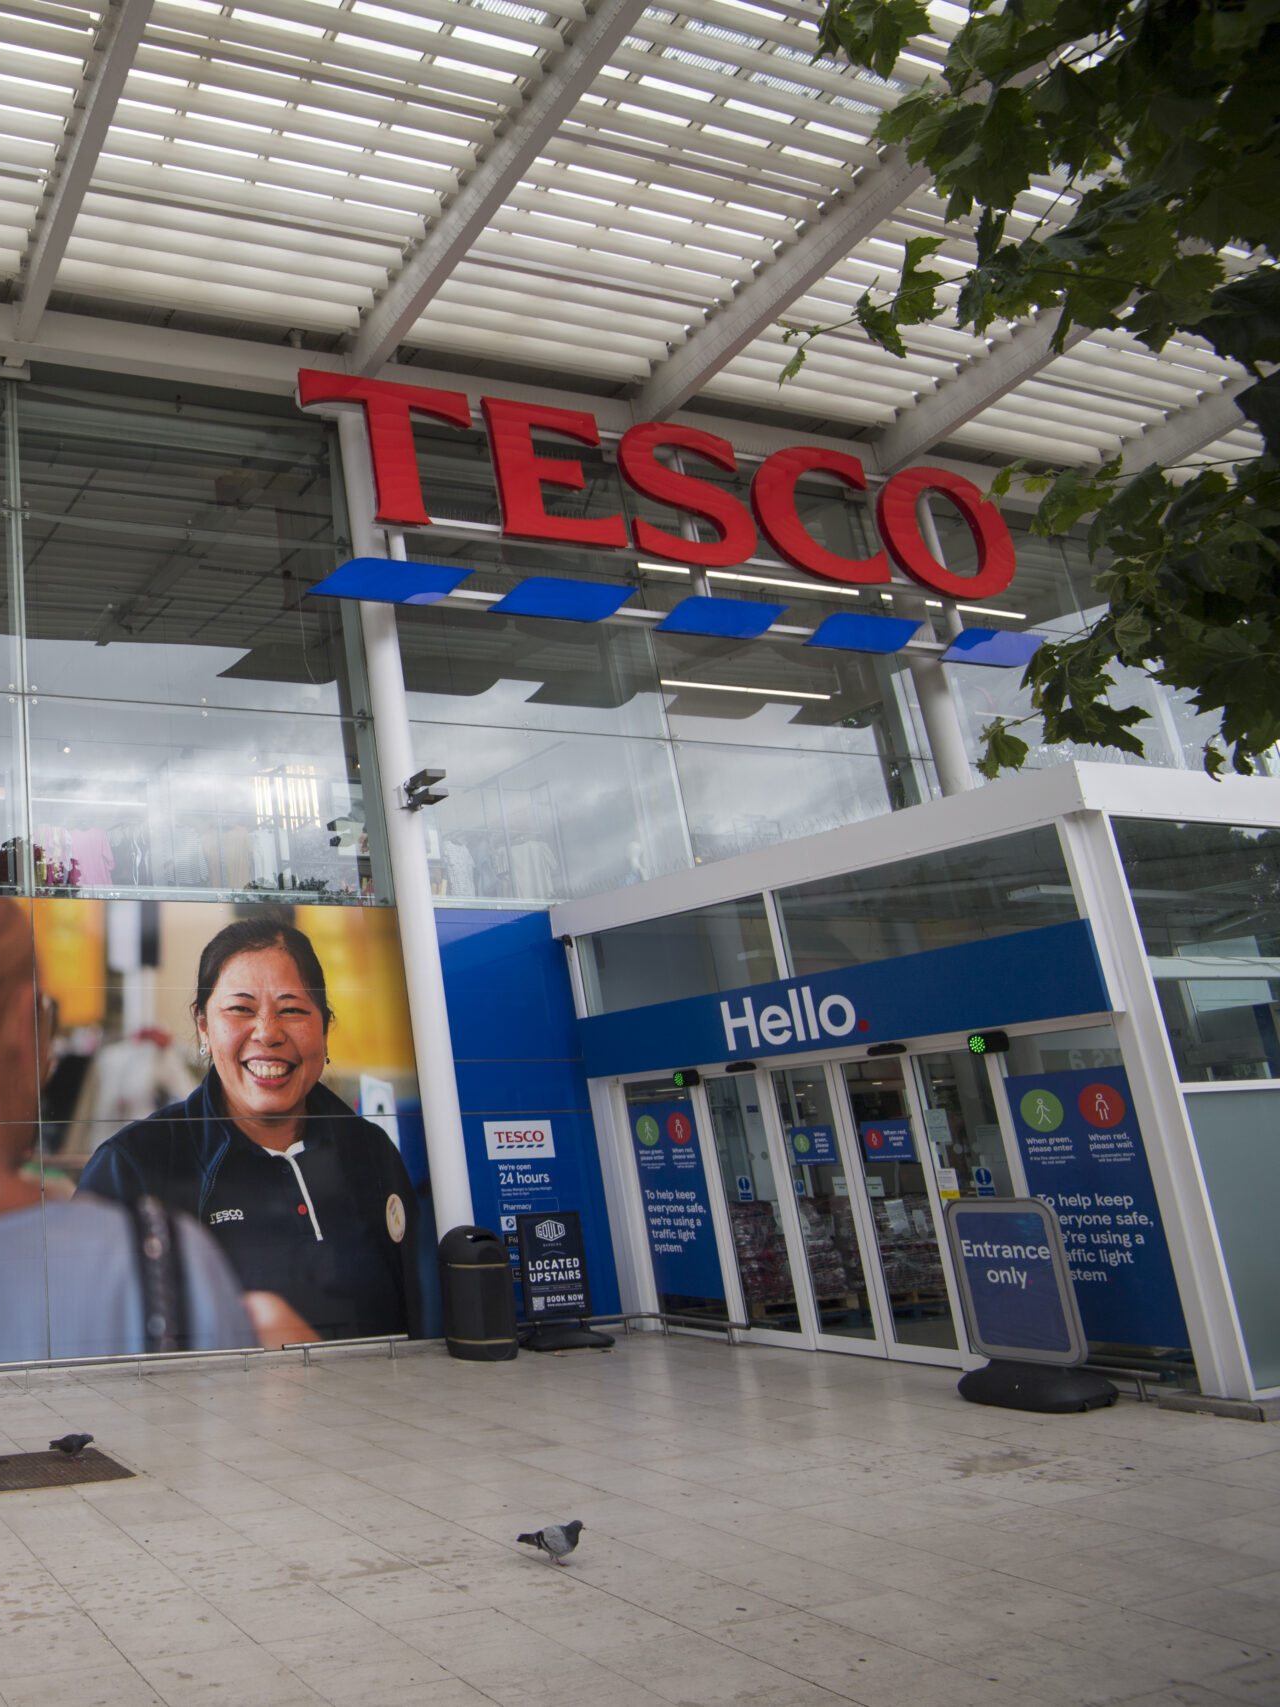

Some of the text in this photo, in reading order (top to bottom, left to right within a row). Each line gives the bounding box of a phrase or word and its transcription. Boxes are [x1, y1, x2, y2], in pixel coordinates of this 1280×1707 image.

[299, 368, 1017, 599] TESCO
[720, 985, 870, 1051] Hello.
[494, 1130, 544, 1143] TESCO
[1026, 1137, 1047, 1145] When
[1088, 1132, 1130, 1142] When red,
[1028, 1144, 1073, 1154] please enter
[1089, 1140, 1133, 1151] please wait
[516, 1164, 531, 1172] open
[499, 1172, 514, 1185] 24
[645, 1189, 696, 1201] To help keep
[1058, 1193, 1091, 1209] help
[1094, 1193, 1134, 1209] keep
[503, 1203, 532, 1211] Pharmacy
[648, 1202, 706, 1214] everyone safe,
[650, 1216, 671, 1225] we're
[673, 1216, 695, 1229] using
[1059, 1211, 1154, 1228] eryone safe,
[537, 1221, 563, 1240] GOULD
[652, 1229, 696, 1242] traffic light
[1059, 1231, 1145, 1247] e're using a
[960, 1240, 1051, 1261] Entrance
[1065, 1249, 1134, 1266] affic light
[528, 1258, 580, 1271] LOCATED
[529, 1270, 581, 1283] UPSTAIRS
[986, 1266, 1033, 1289] only.
[1070, 1268, 1112, 1281] stem.
[546, 1293, 584, 1303] BOOK NOW
